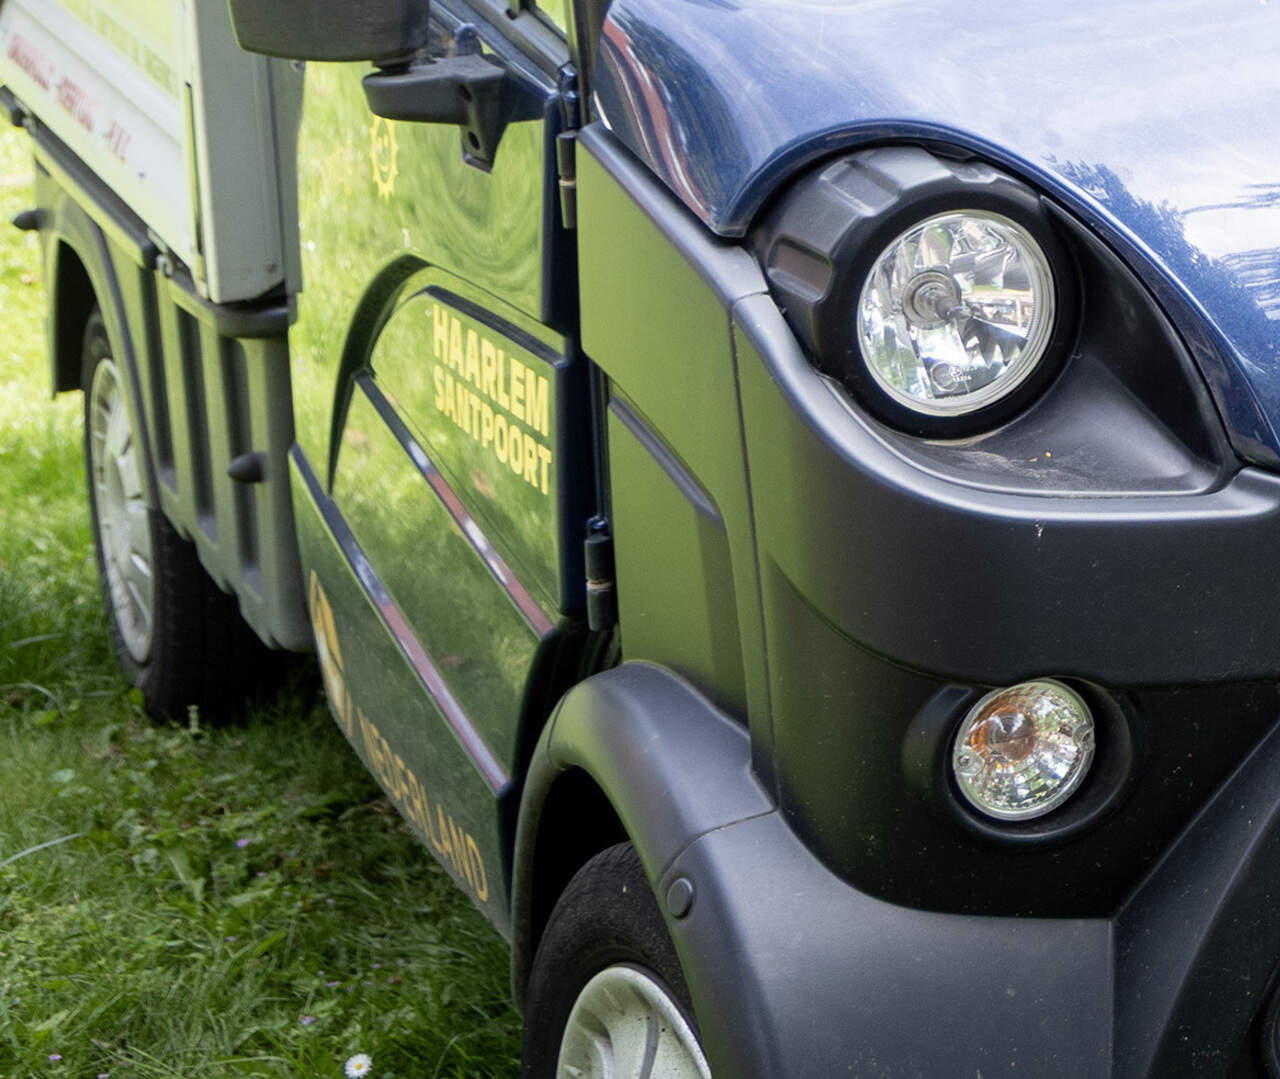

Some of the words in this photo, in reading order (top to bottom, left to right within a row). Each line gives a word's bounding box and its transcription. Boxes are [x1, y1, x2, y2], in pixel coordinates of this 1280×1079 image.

[433, 304, 549, 437] HAARLEM
[434, 364, 552, 496] SANTPOORT
[357, 706, 489, 902] NEDERLAND
